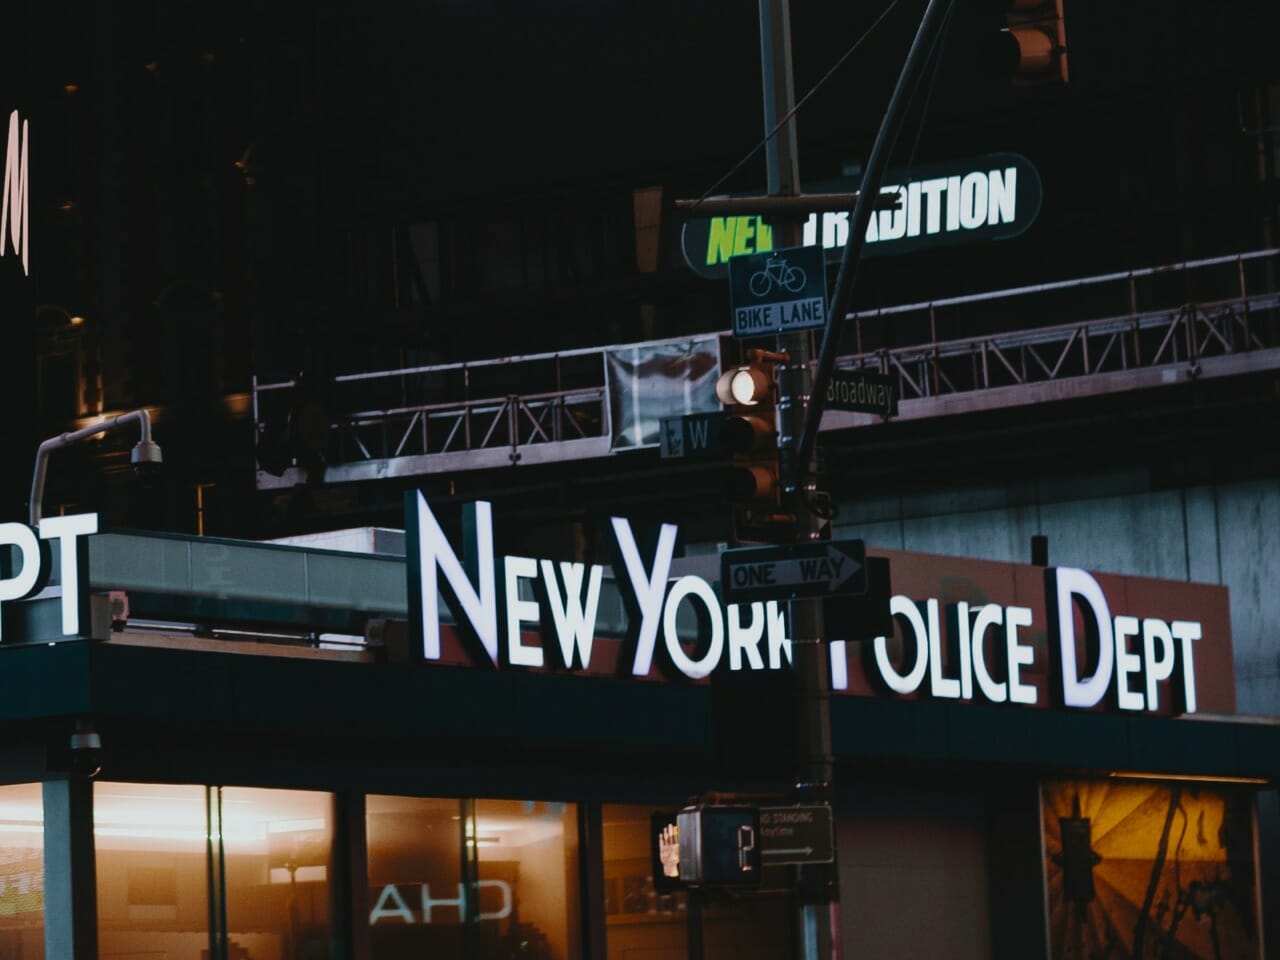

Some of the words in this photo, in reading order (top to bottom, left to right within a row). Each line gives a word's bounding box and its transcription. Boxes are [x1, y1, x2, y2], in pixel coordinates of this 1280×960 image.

[737, 305, 774, 331] BIKE
[780, 301, 823, 326] LANE
[688, 418, 709, 449] W
[733, 563, 777, 587] ONE
[799, 556, 846, 581] WAY
[830, 595, 1039, 706] OLICE
[1054, 566, 1203, 714] DEPT
